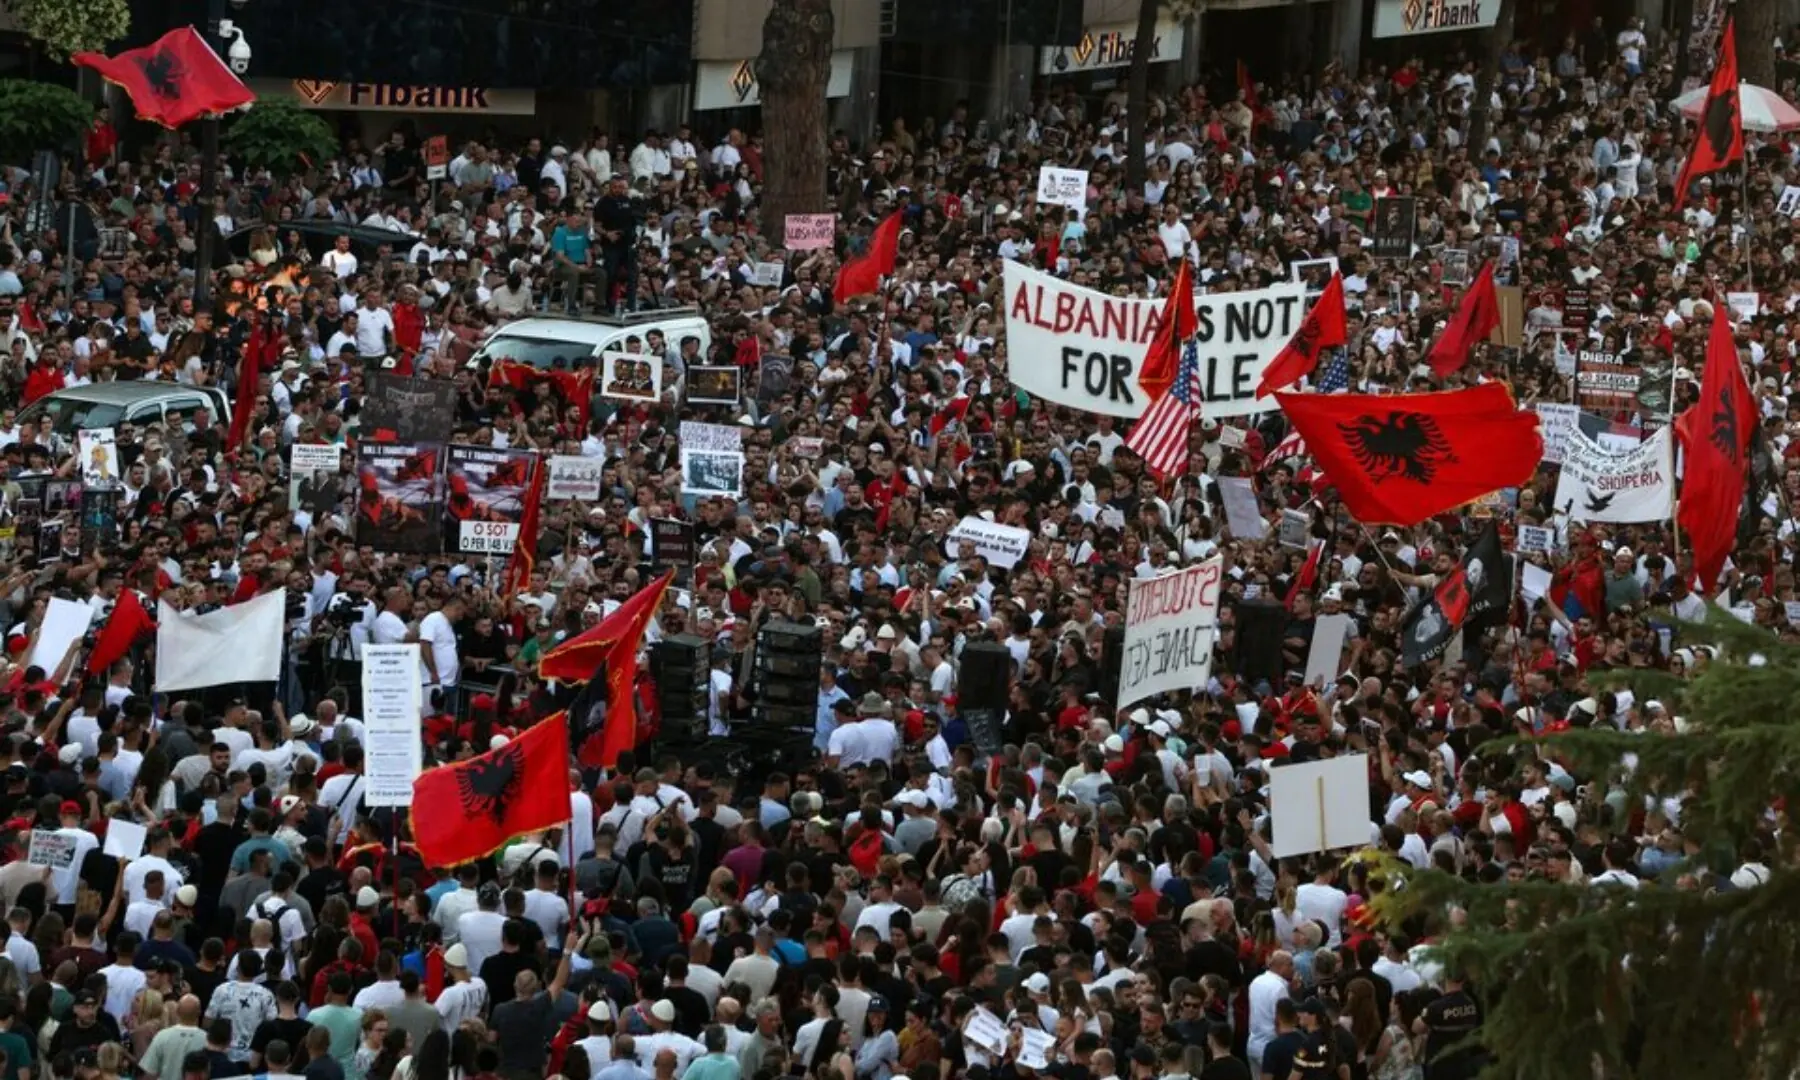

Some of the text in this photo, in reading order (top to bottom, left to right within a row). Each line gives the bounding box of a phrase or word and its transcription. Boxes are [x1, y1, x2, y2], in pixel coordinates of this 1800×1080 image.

[1424, 0, 1481, 28] Fibank
[1011, 280, 1298, 344] ALBANIA S NOT
[1579, 350, 1624, 365] DIBRA
[1061, 346, 1134, 404] FOR
[474, 522, 508, 537] O SOT
